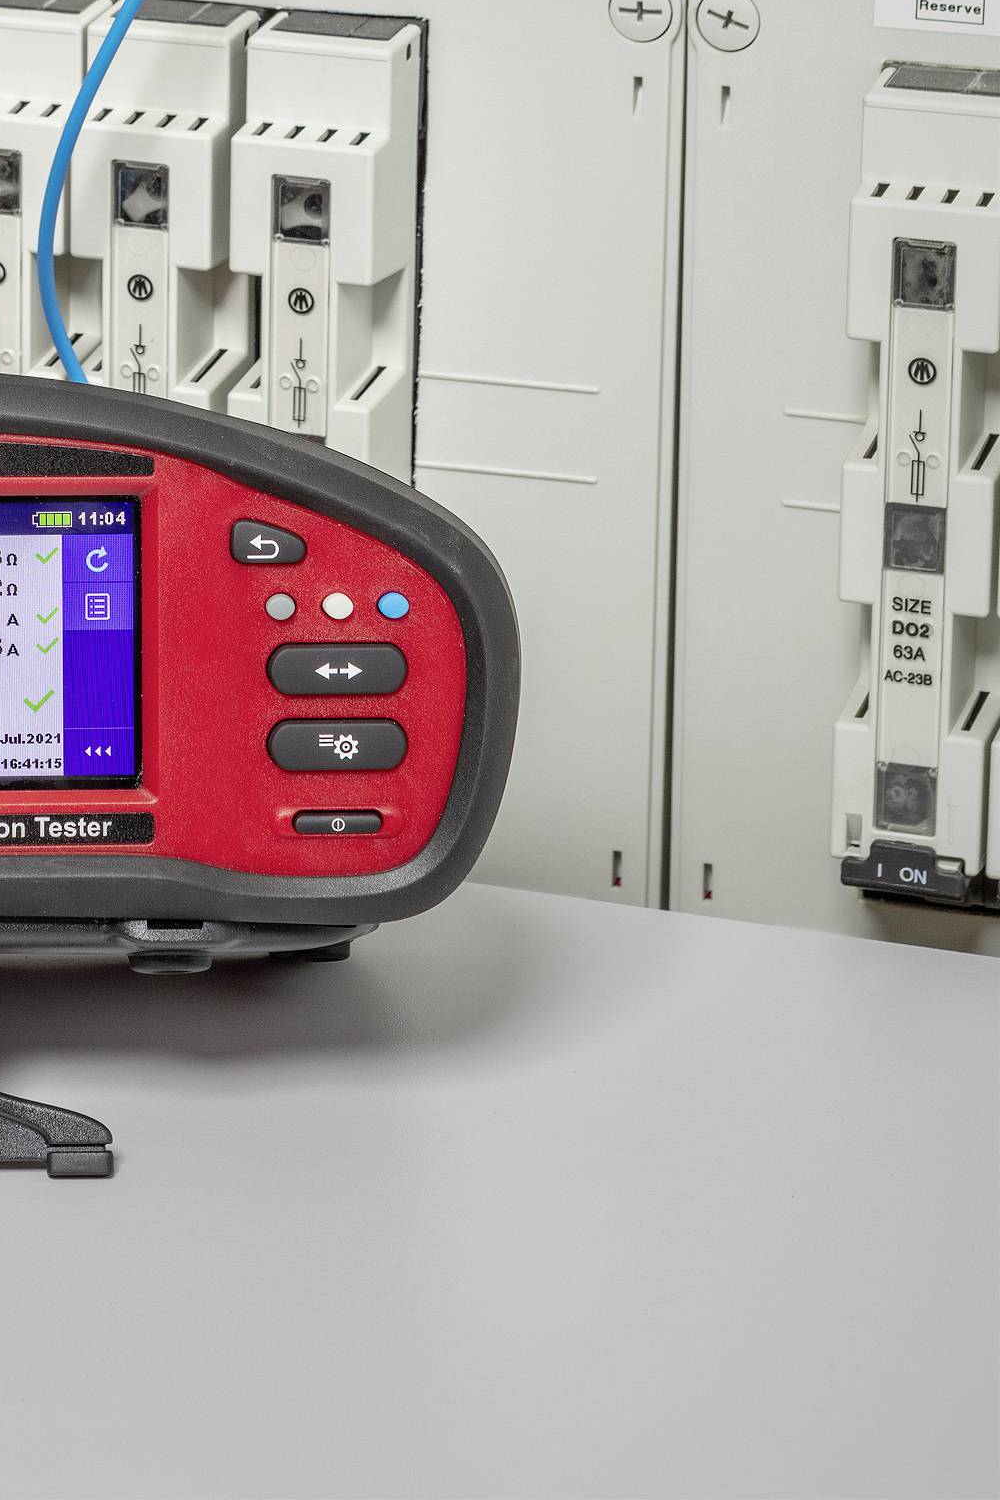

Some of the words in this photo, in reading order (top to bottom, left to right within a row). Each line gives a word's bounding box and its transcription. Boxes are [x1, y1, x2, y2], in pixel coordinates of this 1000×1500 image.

[920, 0, 981, 15] Reserve
[78, 511, 126, 526] 11:04
[892, 596, 932, 615] SIZE
[893, 644, 926, 662] 63A
[884, 669, 933, 686] AC-23B
[1, 758, 62, 769] 16:41:15
[34, 816, 113, 838] Tester
[899, 866, 928, 885] ON
